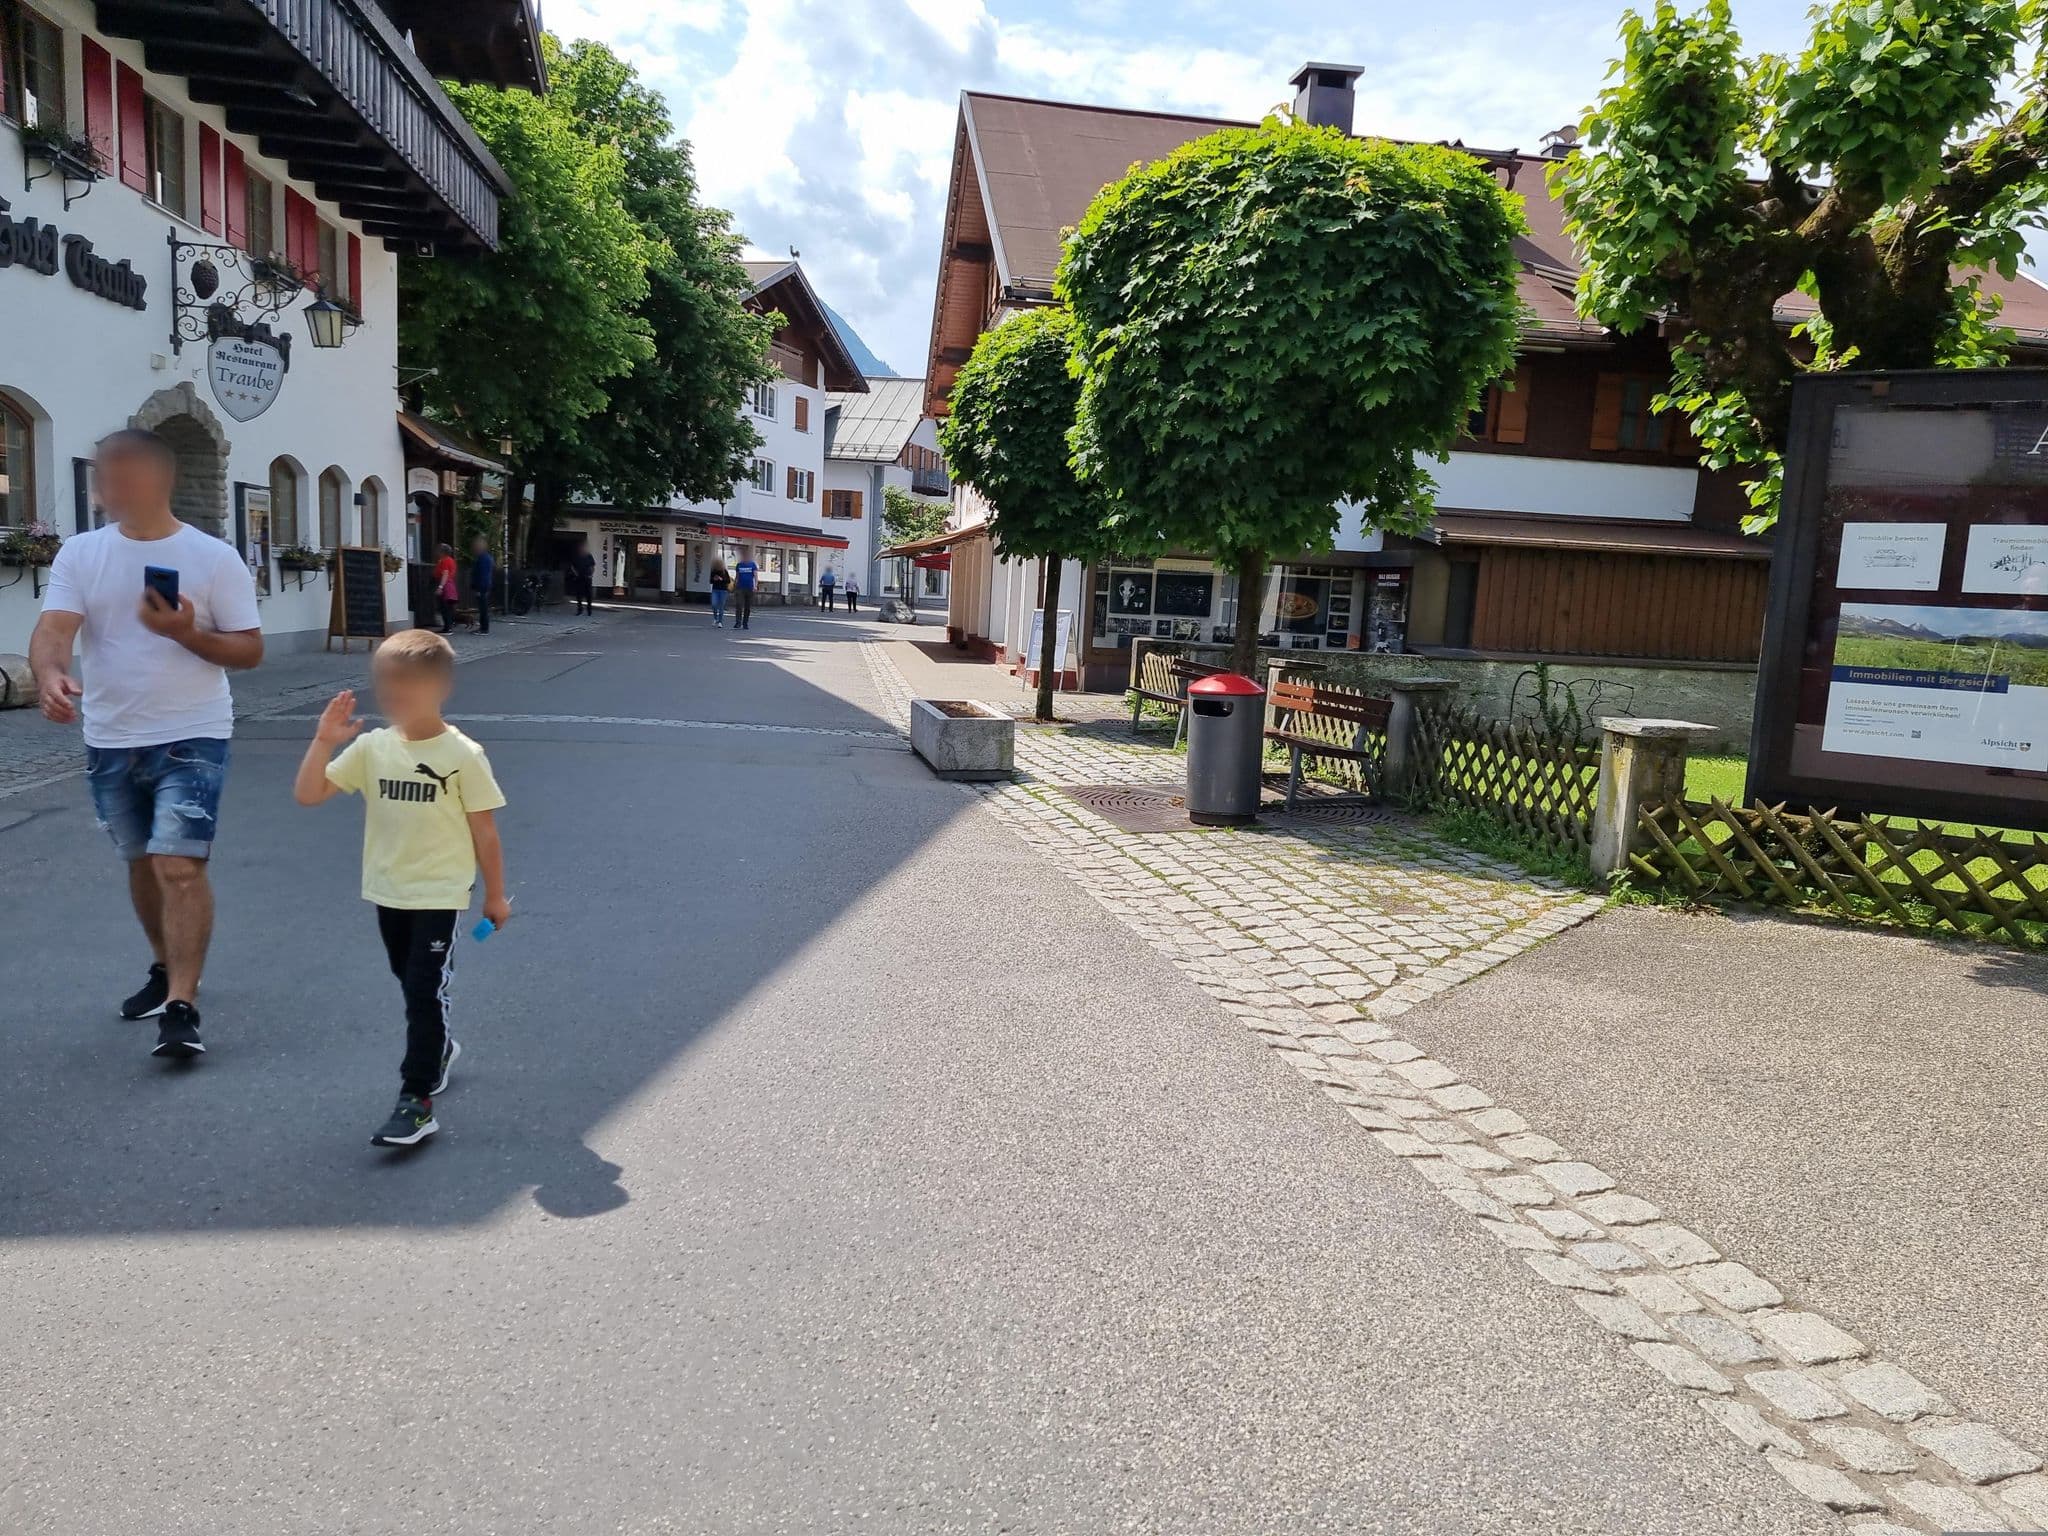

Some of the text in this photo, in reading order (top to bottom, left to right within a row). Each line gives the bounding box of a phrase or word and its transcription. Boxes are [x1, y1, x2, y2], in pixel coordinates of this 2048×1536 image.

[232, 343, 263, 357] Hotel
[215, 350, 278, 371] Restaurant
[216, 366, 274, 391] Traube
[1849, 669, 1996, 688] Immobilien mit Bergsicht
[1843, 727, 1906, 738] www.alpsicht.com
[1980, 737, 2018, 749] Alpsicht
[378, 777, 437, 803] PUMA
